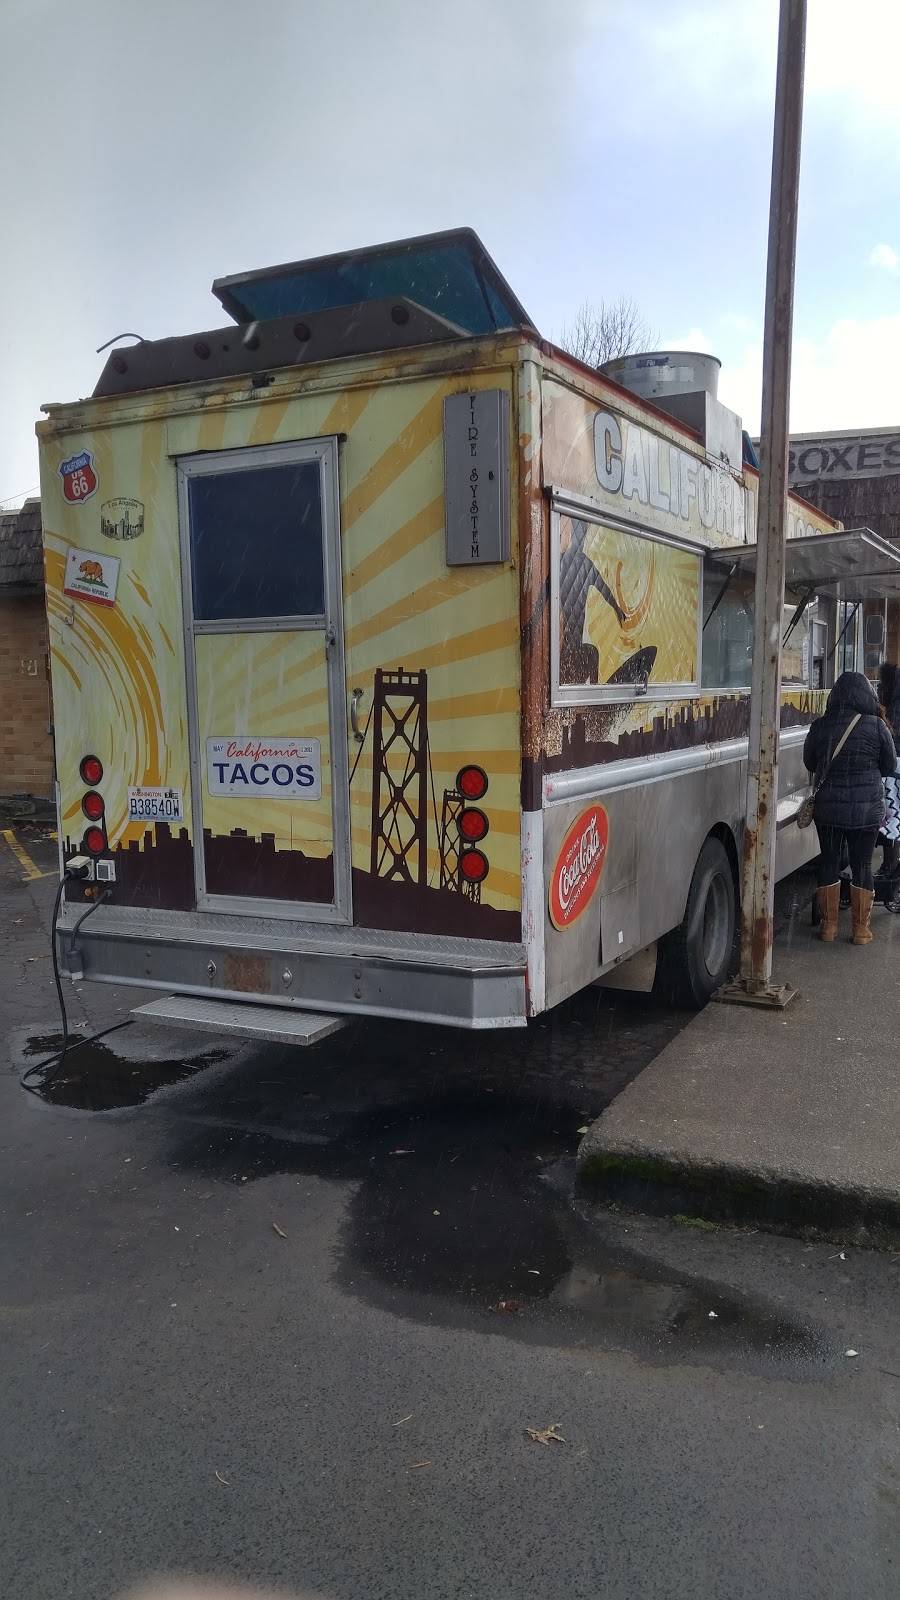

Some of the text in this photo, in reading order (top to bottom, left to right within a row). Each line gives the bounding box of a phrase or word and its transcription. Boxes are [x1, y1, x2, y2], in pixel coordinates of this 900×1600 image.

[71, 469, 84, 480] US
[468, 395, 480, 558] FIRE SYSTEM
[72, 476, 88, 497] 66
[226, 741, 309, 762] California
[212, 762, 315, 787] TACOS
